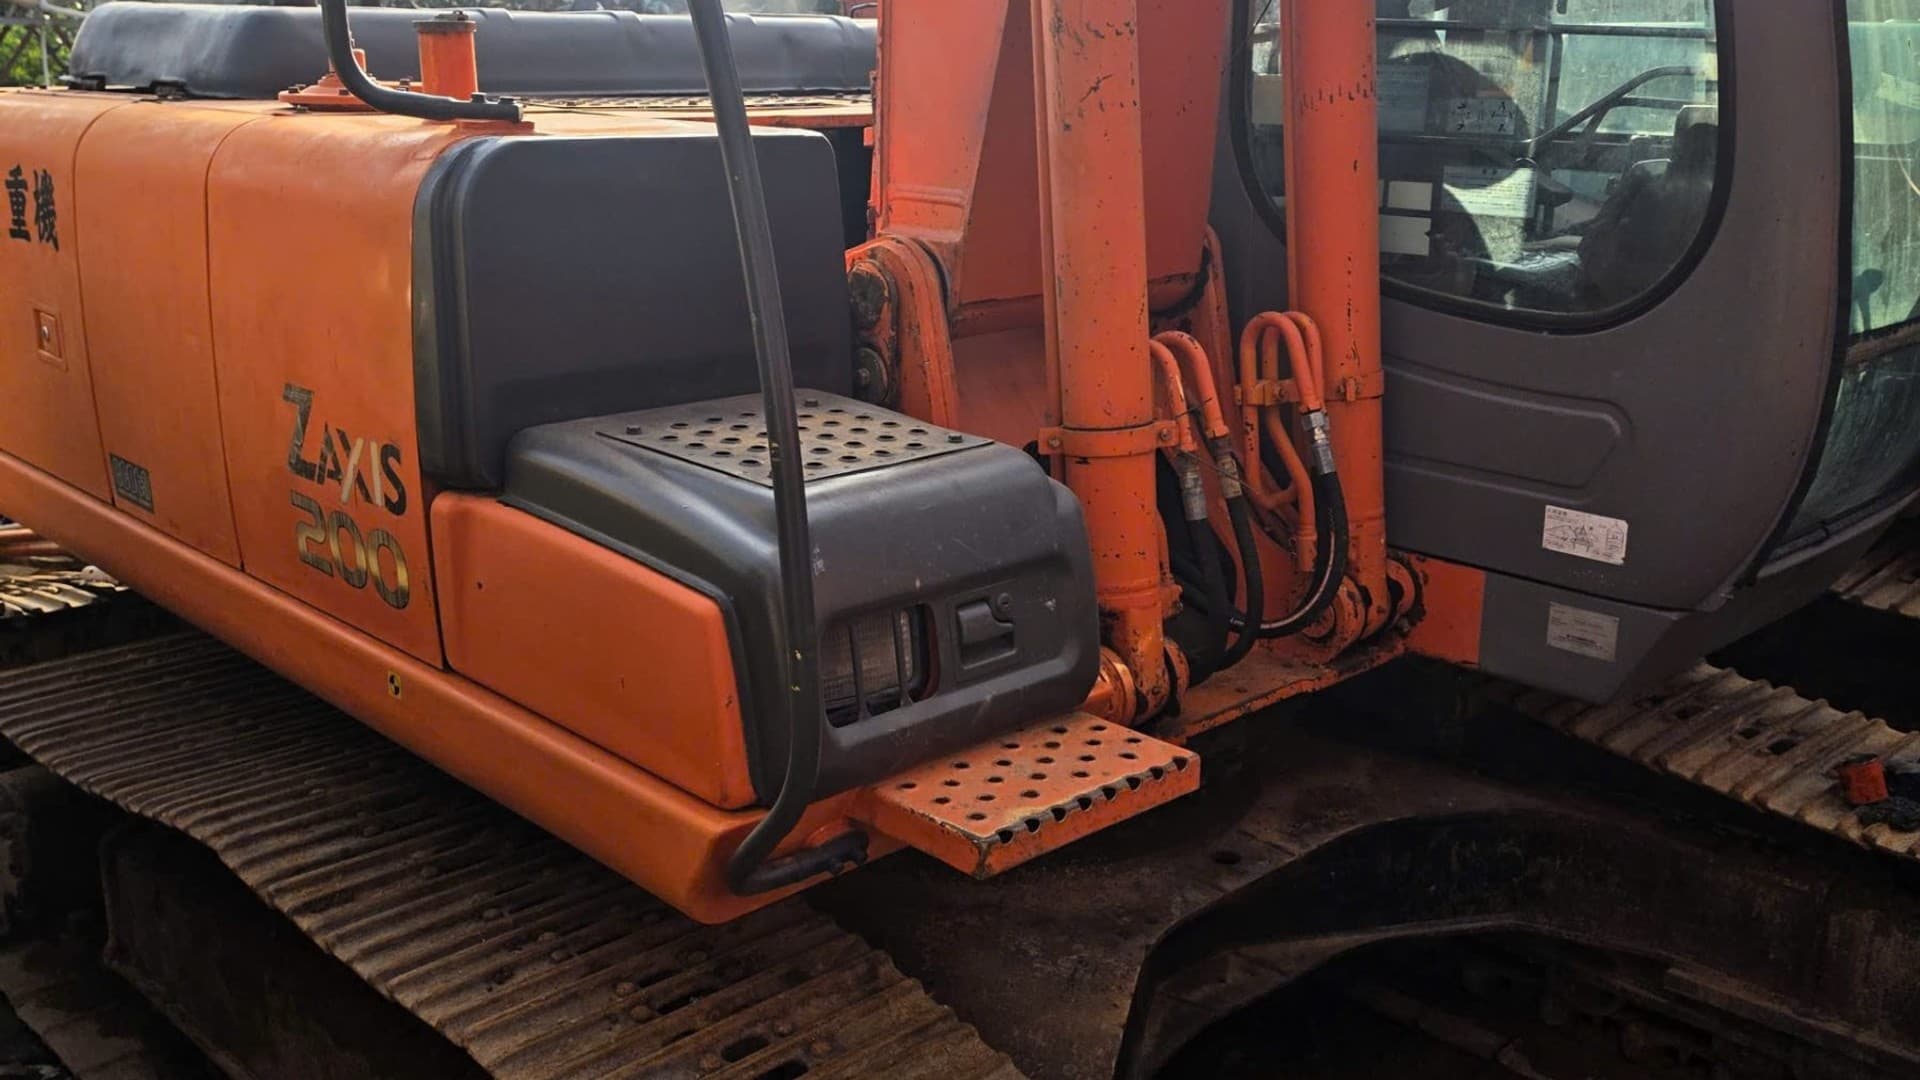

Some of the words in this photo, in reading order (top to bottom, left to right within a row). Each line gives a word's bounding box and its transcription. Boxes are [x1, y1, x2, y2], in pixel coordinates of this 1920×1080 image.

[5, 164, 60, 252] 重機
[283, 382, 407, 517] ZAXIS
[290, 489, 411, 611] 200
